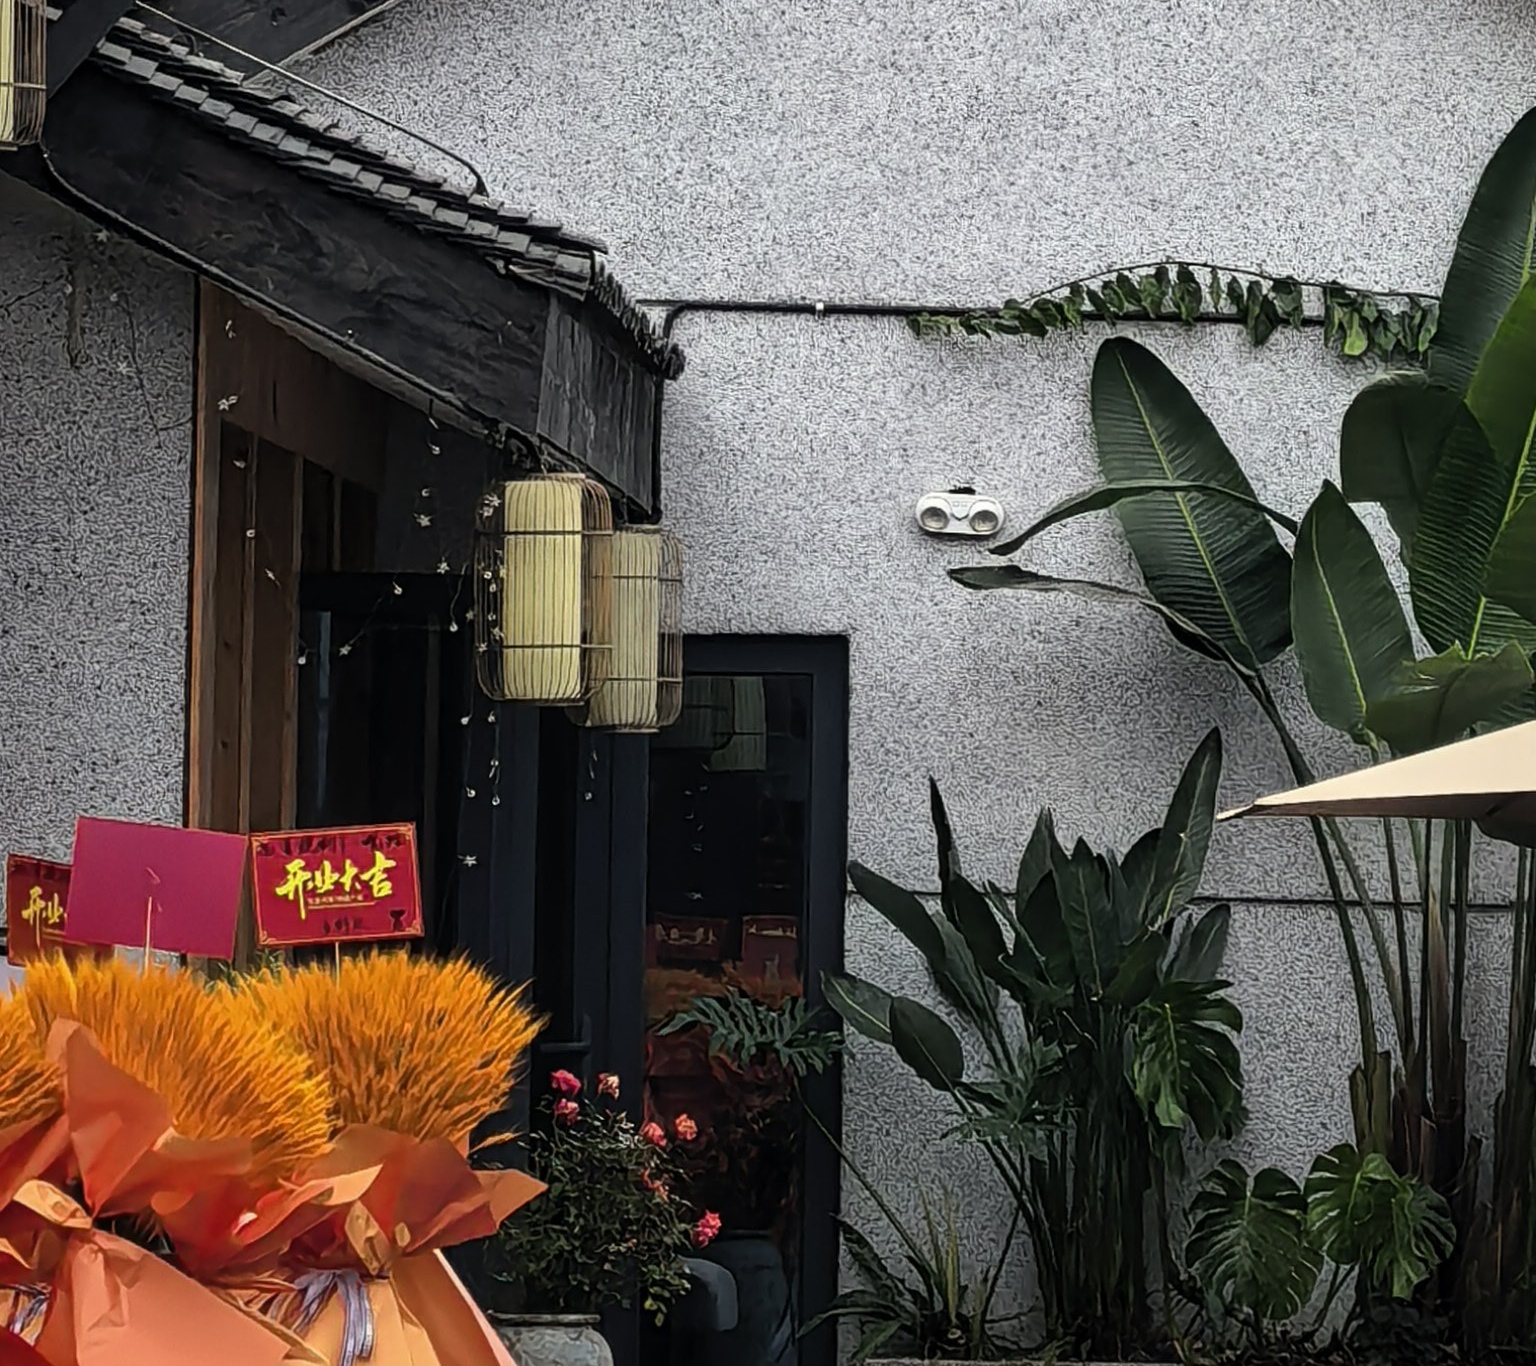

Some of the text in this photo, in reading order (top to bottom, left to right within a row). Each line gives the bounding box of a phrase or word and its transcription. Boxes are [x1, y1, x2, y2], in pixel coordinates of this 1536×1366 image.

[21, 885, 67, 948] 开业
[275, 850, 397, 920] 开业大吉
